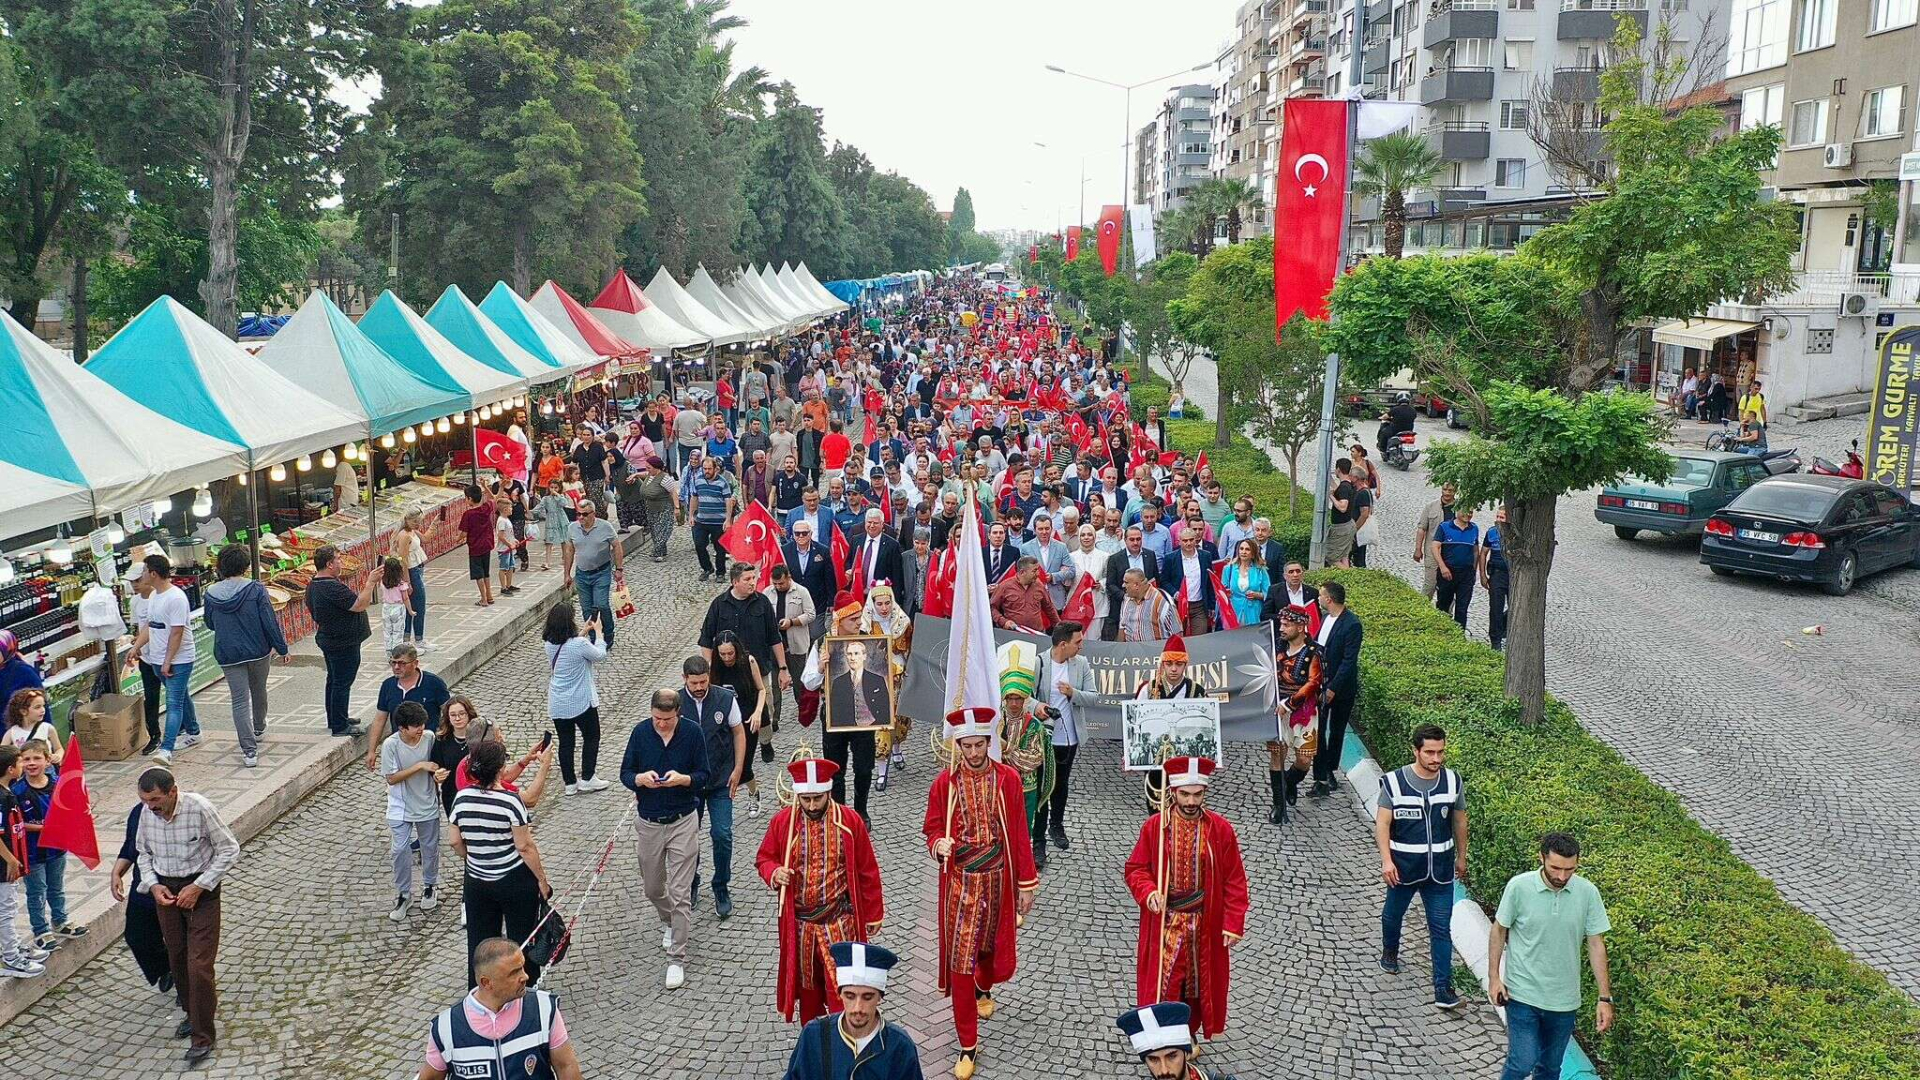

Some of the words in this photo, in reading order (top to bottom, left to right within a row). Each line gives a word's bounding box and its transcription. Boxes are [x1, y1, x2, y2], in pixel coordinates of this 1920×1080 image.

[1883, 342, 1912, 418] GURME
[1905, 393, 1918, 432] KAHVALTI
[456, 1065, 485, 1075] POLİS
